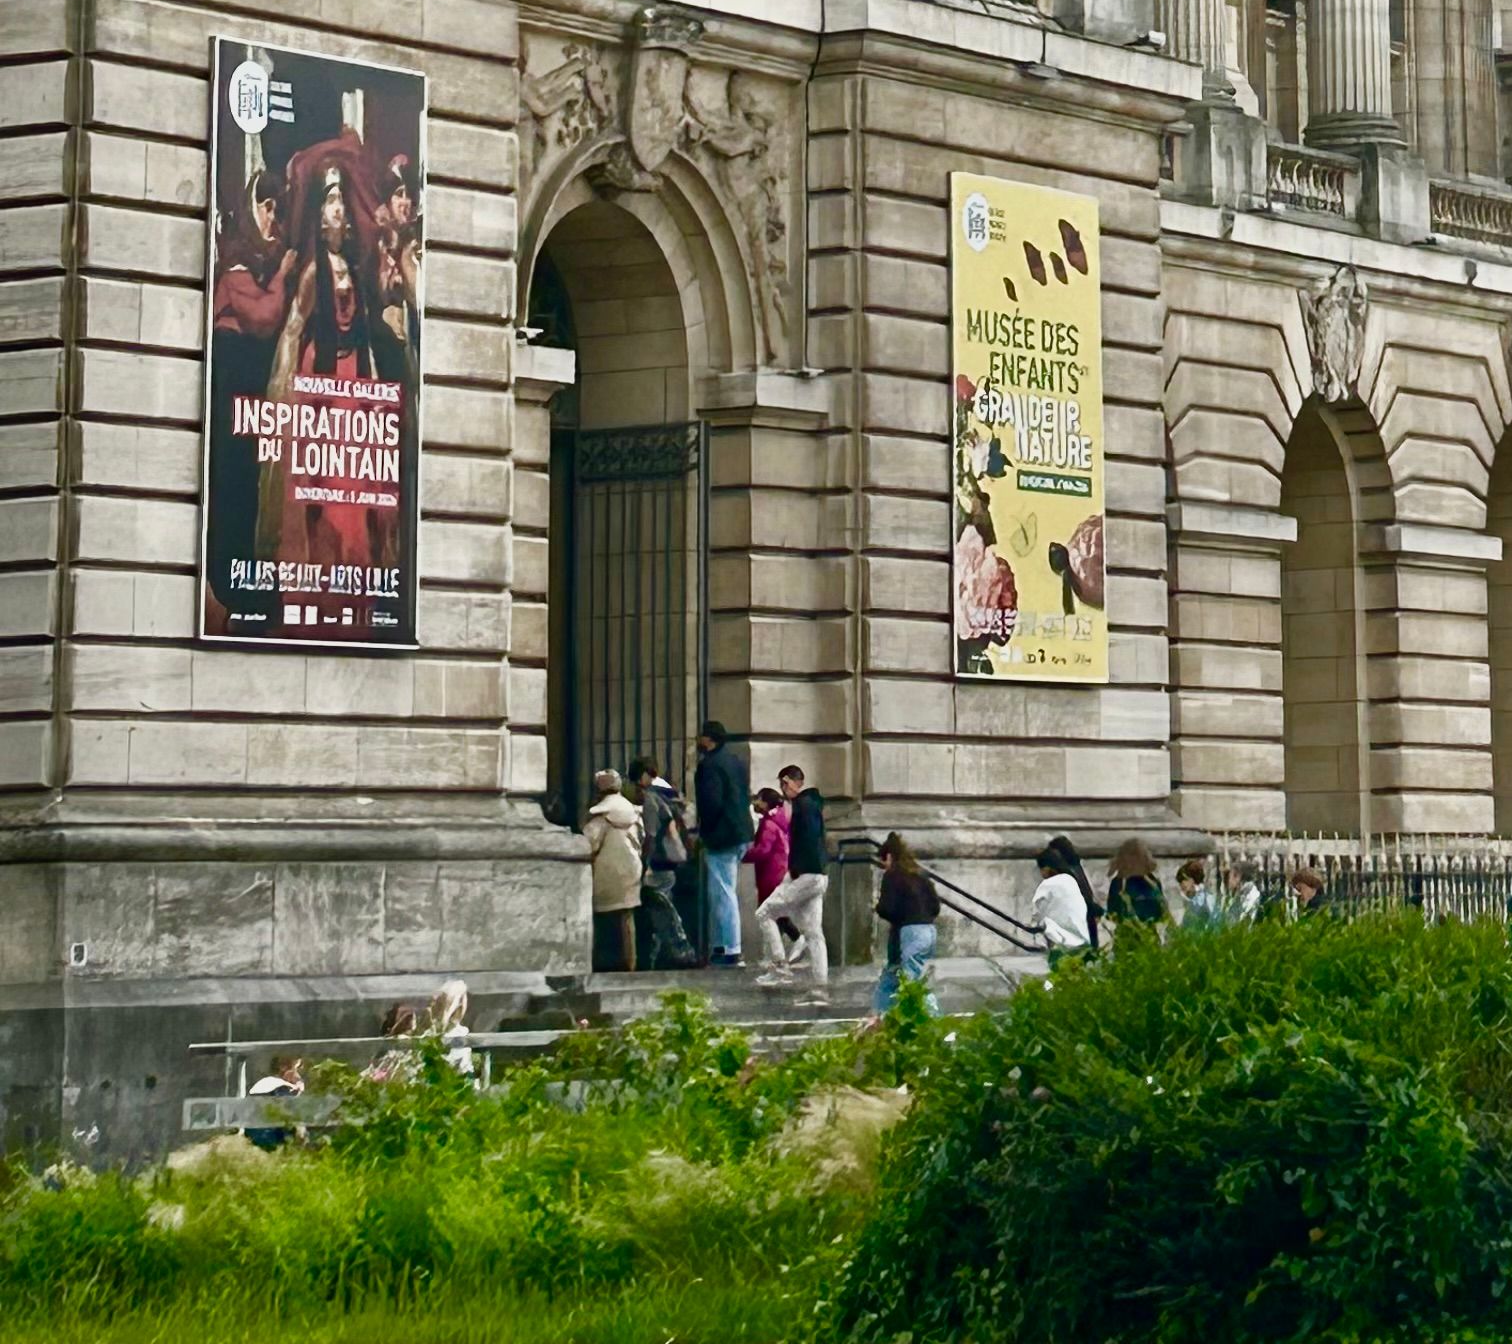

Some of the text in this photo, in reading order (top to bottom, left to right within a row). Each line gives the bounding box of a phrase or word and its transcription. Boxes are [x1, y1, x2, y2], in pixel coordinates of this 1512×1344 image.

[967, 308, 1080, 356] MUSÉE DES
[989, 351, 1080, 394] ENFANTS
[232, 397, 400, 446] INSPIRATIONS
[258, 437, 400, 482] DU LOINTAIN
[1014, 424, 1093, 471] NATURE
